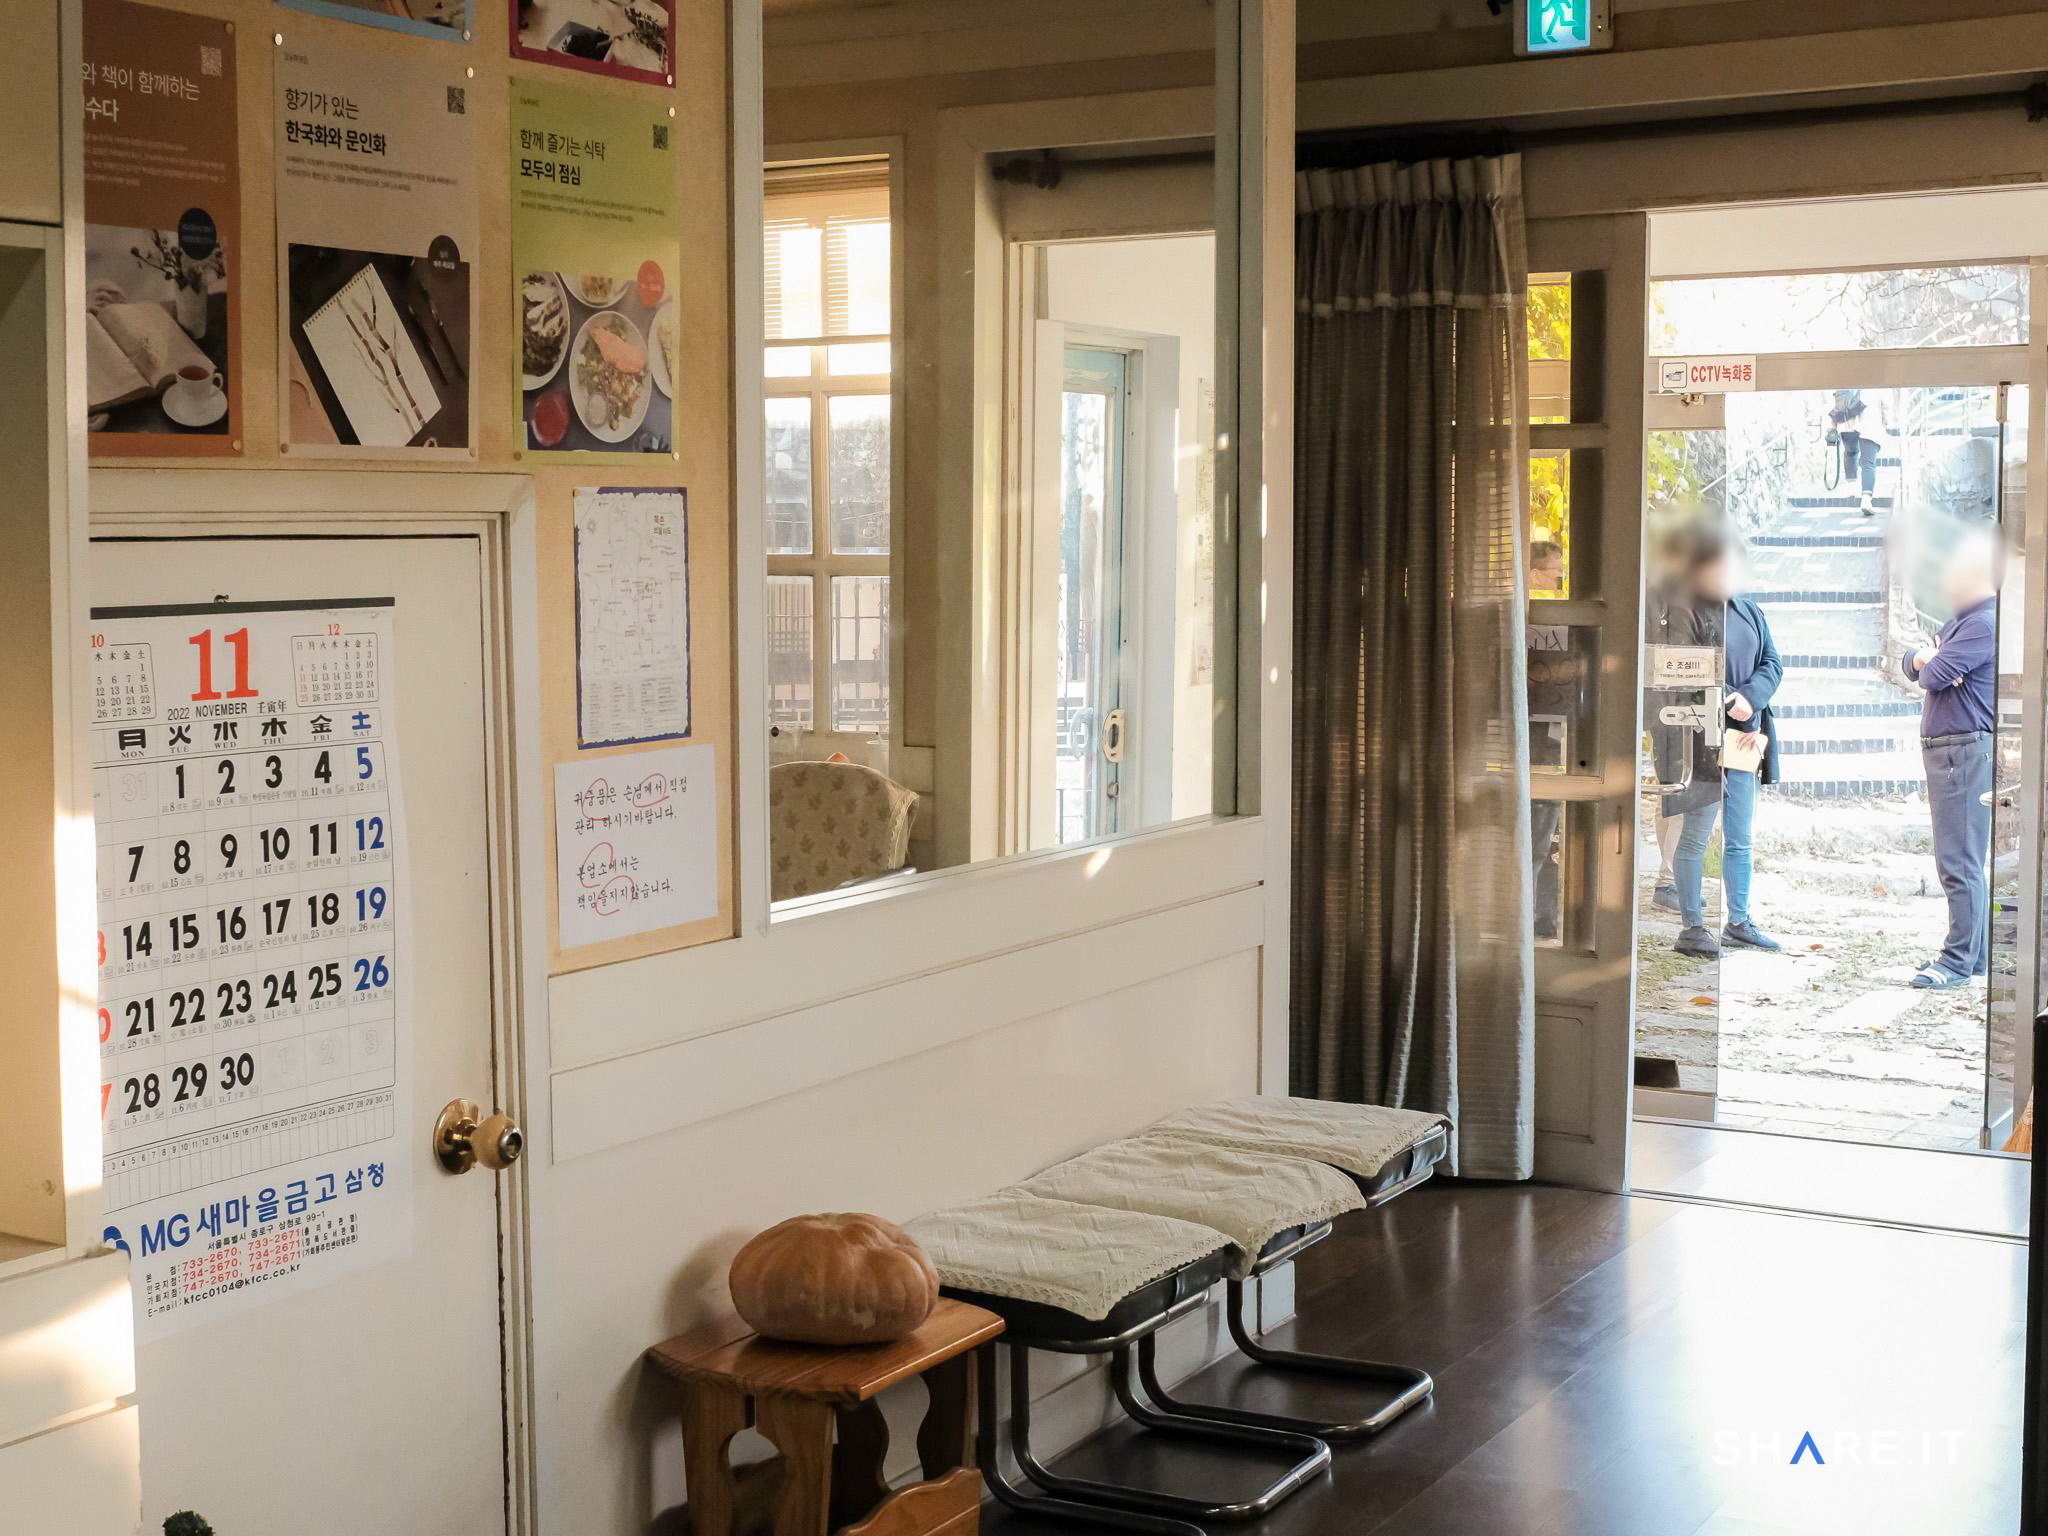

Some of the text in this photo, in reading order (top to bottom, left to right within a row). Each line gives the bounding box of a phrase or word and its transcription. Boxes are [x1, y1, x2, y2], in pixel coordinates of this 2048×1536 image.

[81, 63, 200, 101] 와 책이 함께하는
[84, 97, 119, 123] 수다
[285, 88, 359, 120] 향기가 있는
[285, 119, 387, 156] 한국화와 문인화
[520, 128, 606, 161] 함께 즐기는 식탁
[520, 159, 581, 186] 모두의 점심
[1691, 364, 1752, 383] CCTV녹화중
[91, 634, 104, 647] 10
[328, 624, 340, 636] 12
[189, 628, 259, 701] 11
[1666, 661, 1673, 670] 손
[96, 685, 149, 696] 12 13 14 15
[97, 696, 150, 707] 19 20 21 22
[97, 706, 151, 718] 26 27 28 29
[168, 700, 287, 721] 2022 NOVEMBER 壬寅年
[169, 724, 191, 746] 火
[214, 721, 237, 741] 水
[261, 718, 287, 737] 木
[310, 714, 332, 734] 金
[352, 711, 371, 730] 土
[176, 764, 184, 799] 1
[218, 760, 235, 794] 2
[265, 755, 283, 788] 3
[314, 751, 332, 783] 4
[357, 747, 373, 779] 5
[574, 787, 617, 807] 귀중품은
[670, 776, 687, 793] 직접
[575, 819, 595, 835] 관리
[128, 816, 384, 882] 7 8 9 10 11 12
[123, 921, 152, 960] 14
[169, 913, 199, 951] 15
[217, 906, 247, 943] 16
[262, 899, 291, 935] 17
[308, 893, 339, 928] 18
[356, 887, 386, 921] 19
[125, 997, 154, 1037] 21
[169, 988, 205, 1027] 22
[217, 980, 252, 1018] 23
[263, 970, 297, 1009] 24
[308, 962, 342, 1000] 25
[354, 955, 389, 991] 26
[124, 1073, 161, 1114] 28
[172, 1062, 207, 1102] 29
[220, 1052, 254, 1090] 30
[181, 1143, 189, 1151] 10
[192, 1141, 199, 1149] 11
[202, 1138, 209, 1146] 12
[212, 1135, 219, 1144] 13
[222, 1133, 229, 1141] 14
[232, 1130, 239, 1138] 15
[242, 1128, 249, 1136] 16
[252, 1125, 259, 1133] 17
[261, 1123, 269, 1131] 18
[271, 1120, 278, 1129] 19
[280, 1118, 288, 1126] 20
[290, 1116, 298, 1124] 21
[300, 1113, 308, 1122] 22
[309, 1111, 317, 1120] 23
[318, 1109, 326, 1118] 24
[328, 1107, 335, 1115] 25
[337, 1104, 345, 1113] 26
[347, 1102, 354, 1111] 27
[356, 1100, 364, 1108] 28
[366, 1098, 373, 1106] 29
[375, 1096, 383, 1104] 30
[385, 1094, 391, 1102] 31
[208, 1232, 246, 1251] 서울특별시
[251, 1224, 274, 1239] 종로구
[306, 1210, 325, 1223] 99-1
